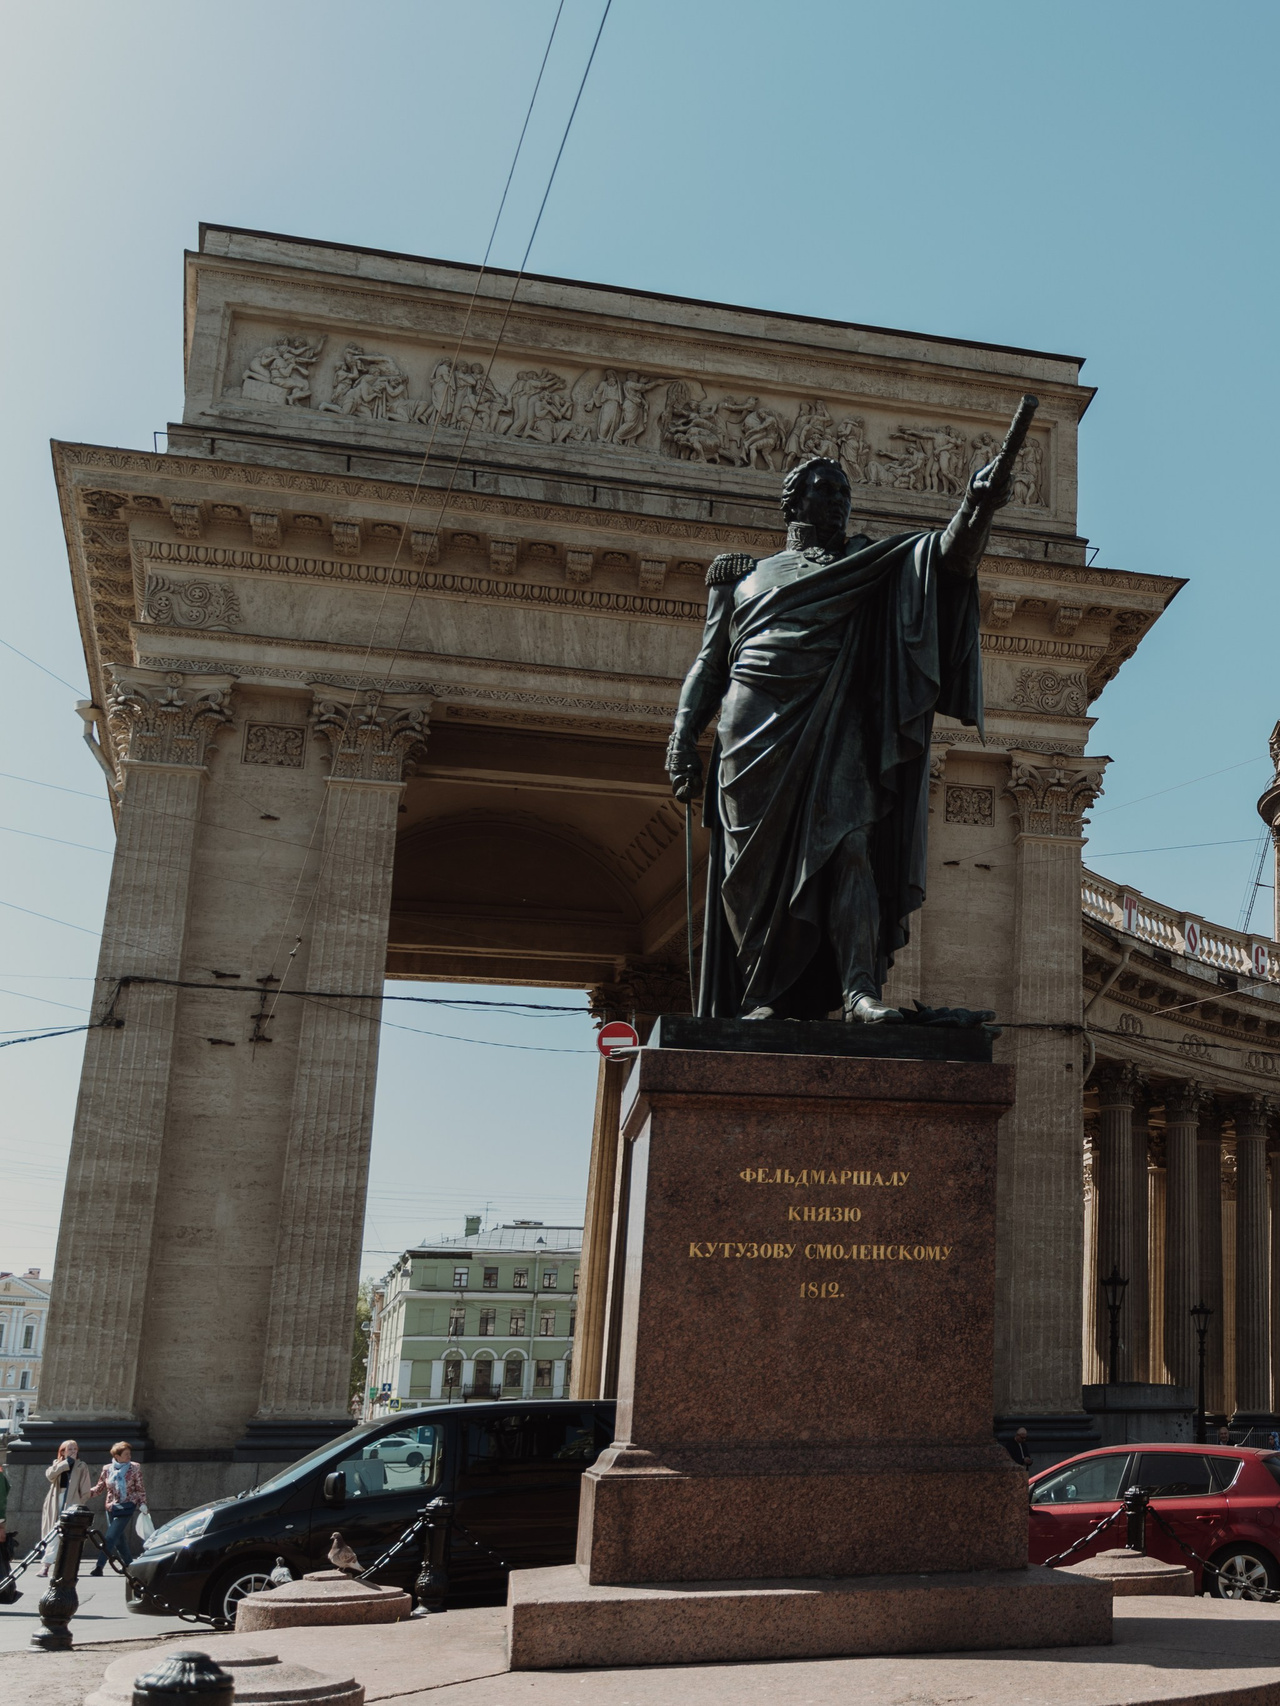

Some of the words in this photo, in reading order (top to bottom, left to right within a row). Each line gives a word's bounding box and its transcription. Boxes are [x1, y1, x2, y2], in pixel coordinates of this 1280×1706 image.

[739, 1168, 910, 1187] ФЕЛЬДМАРШАЛУ
[788, 1206, 861, 1222] КНЯЗЮ
[689, 1242, 797, 1259] КУТУЗОВУ
[804, 1243, 953, 1261] СМОЛЕНСКОМУ
[799, 1281, 845, 1298] 1812.
